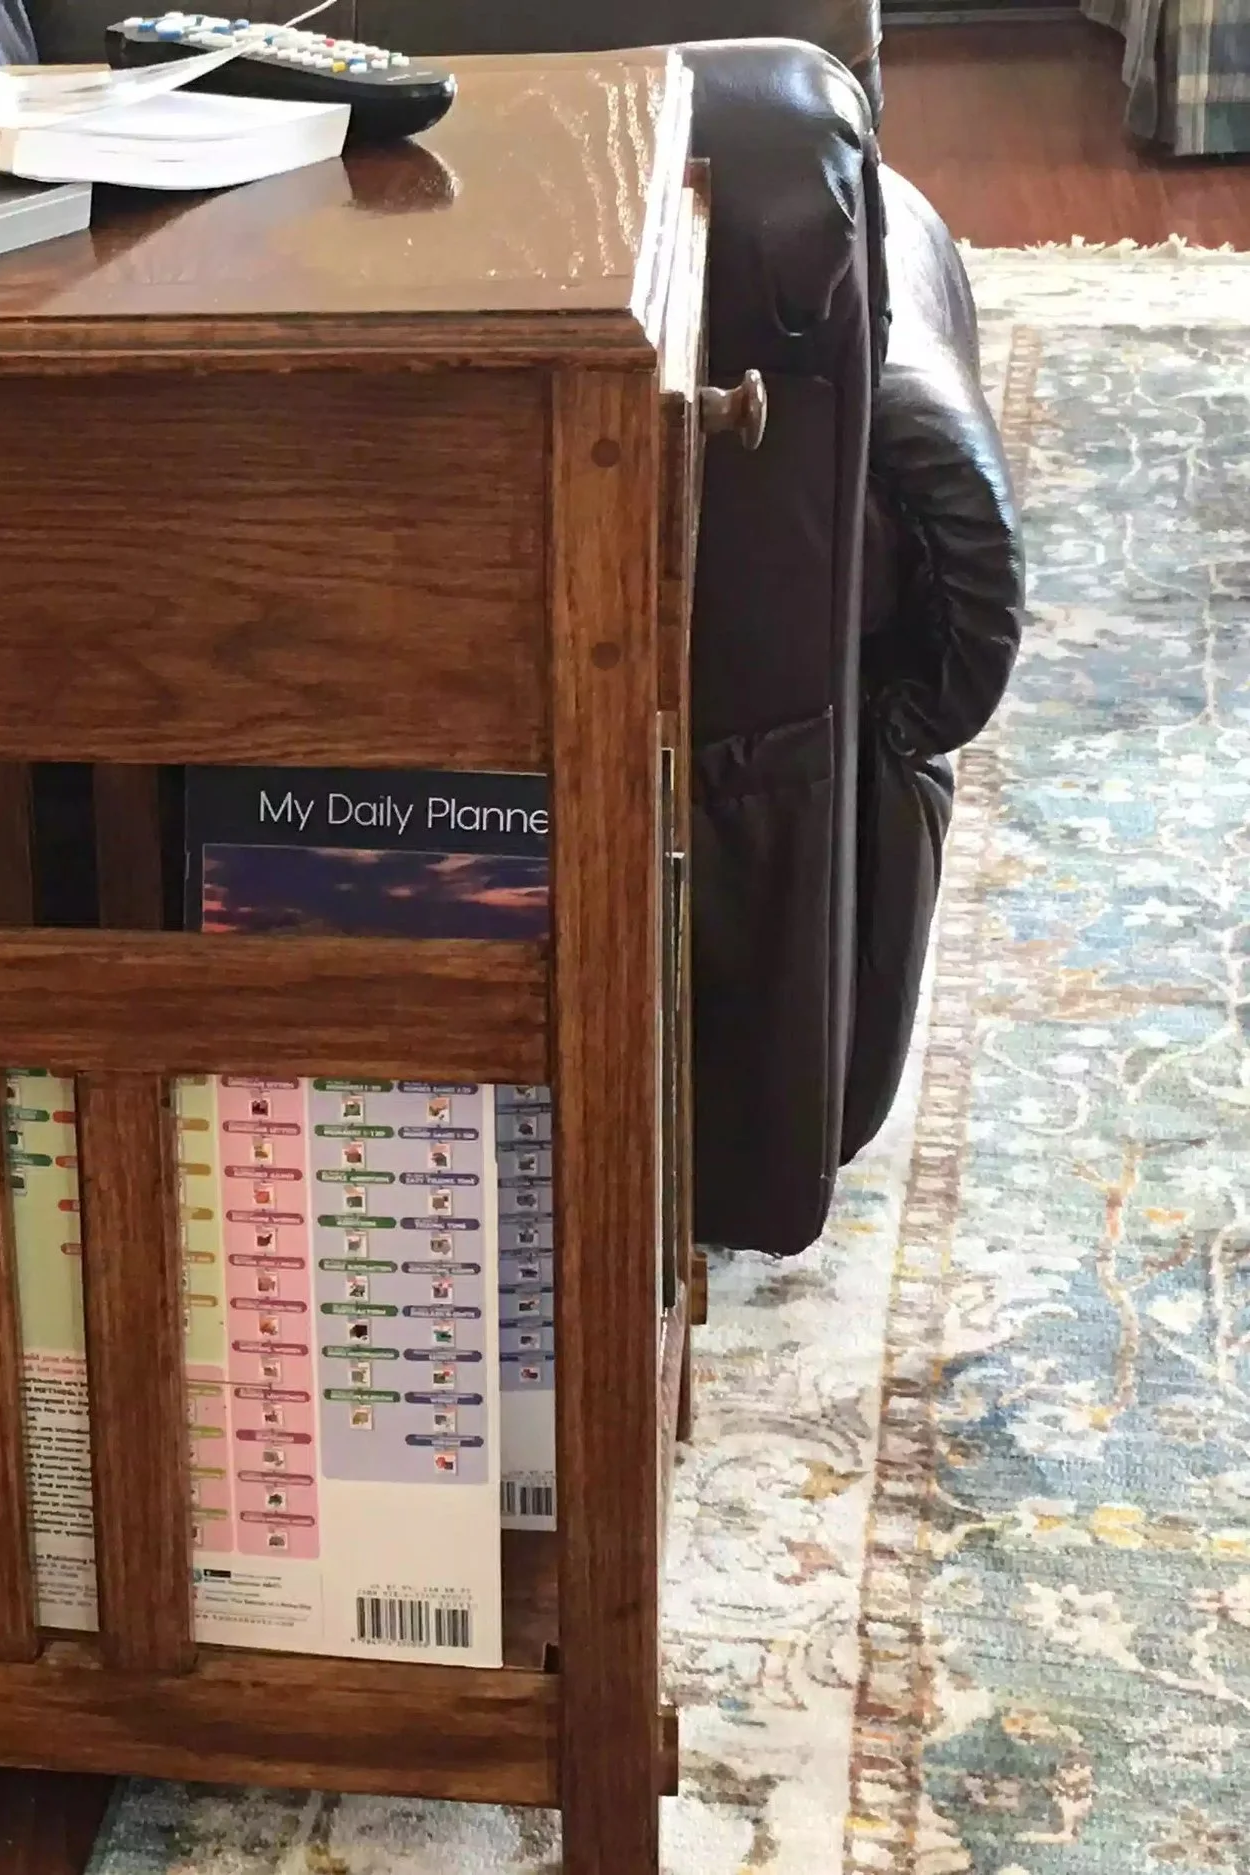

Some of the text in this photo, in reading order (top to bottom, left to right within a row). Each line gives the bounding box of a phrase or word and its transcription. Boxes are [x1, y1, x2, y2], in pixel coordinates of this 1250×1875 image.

[259, 790, 548, 835] My Daily Planne
